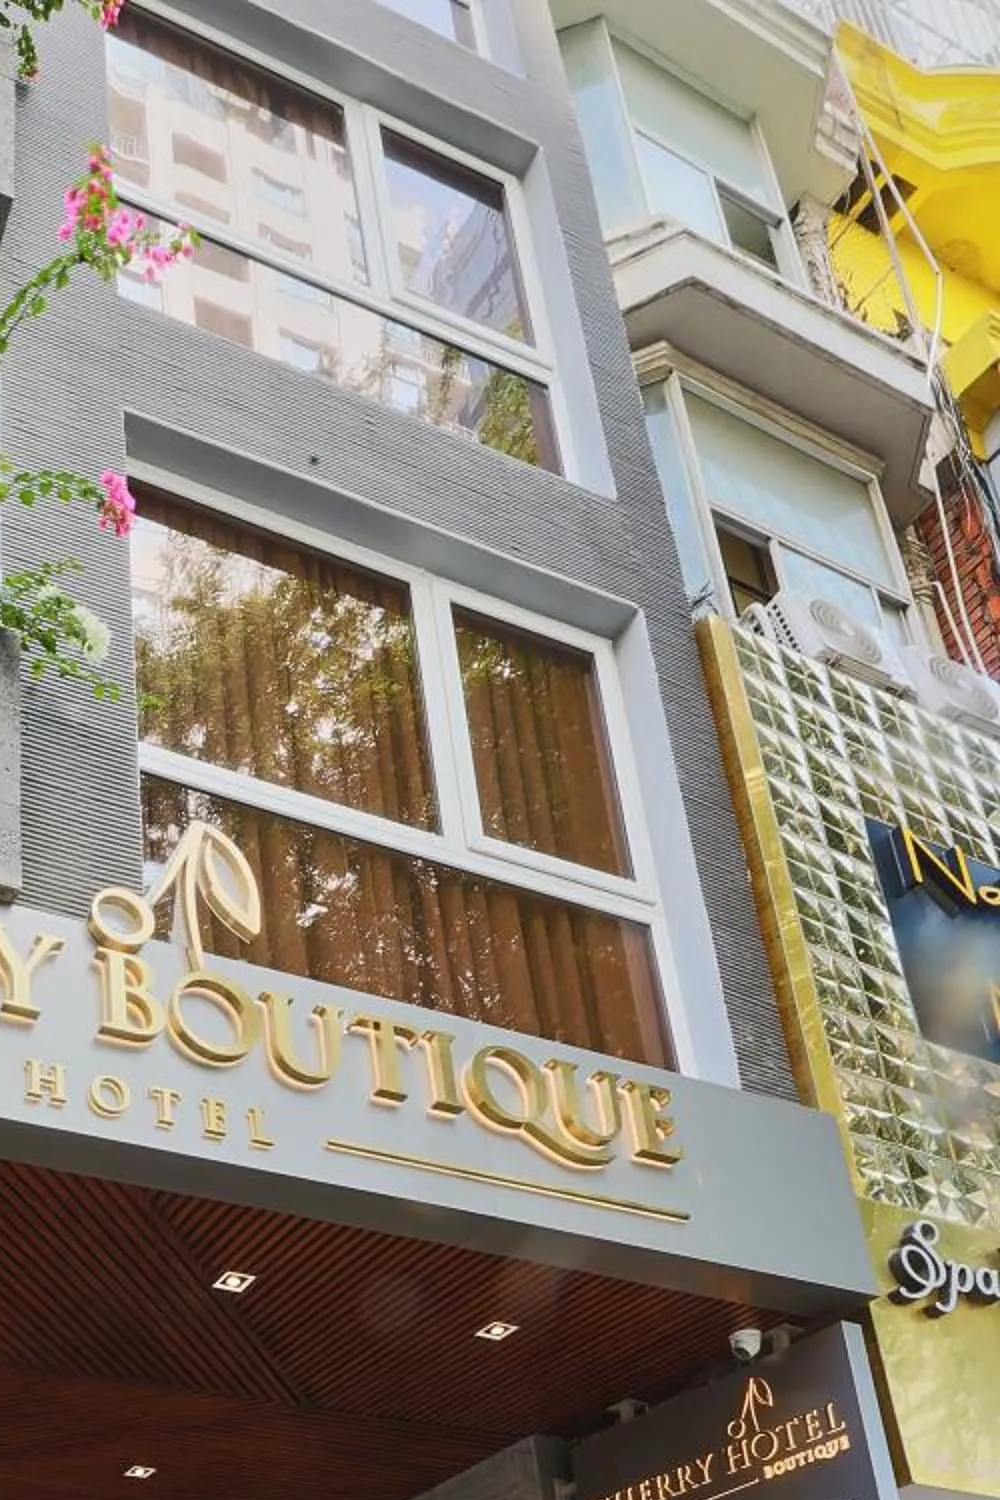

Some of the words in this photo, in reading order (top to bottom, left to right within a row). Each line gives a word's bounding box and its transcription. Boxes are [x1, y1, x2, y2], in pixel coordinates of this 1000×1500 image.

[24, 1056, 275, 1149] HOTEL
[91, 946, 684, 1169] BOUTIQUE
[900, 1220, 1000, 1312] Spa
[724, 1402, 846, 1475] HOTEL
[764, 1435, 850, 1480] BOUTIQUE
